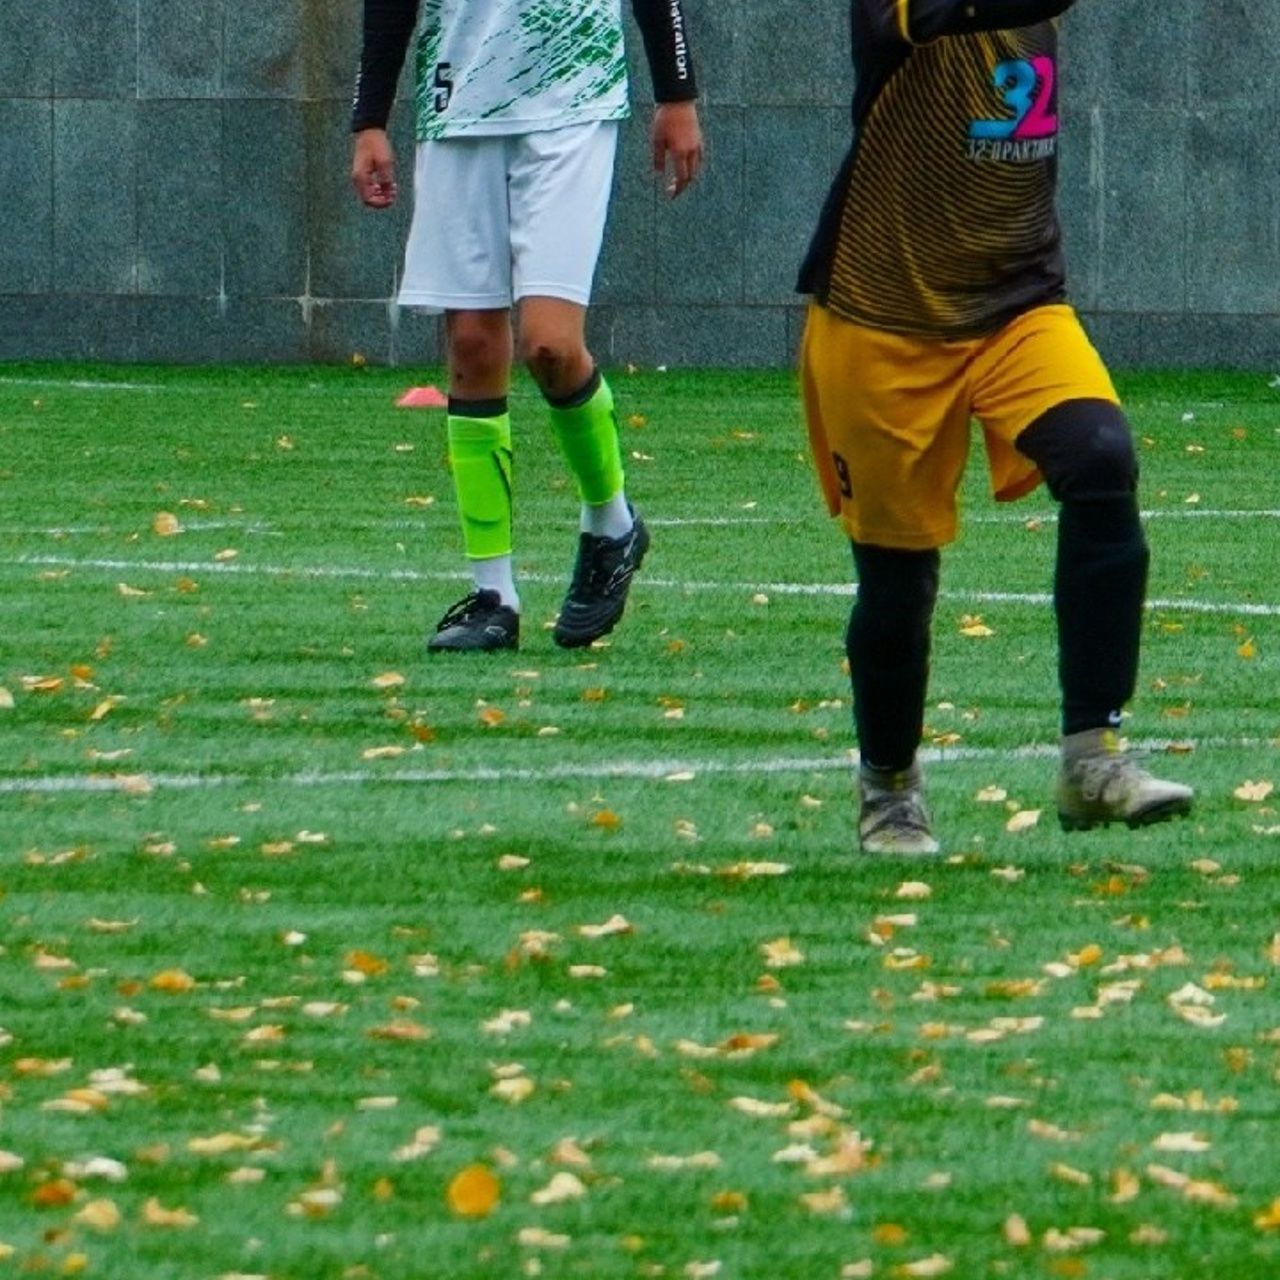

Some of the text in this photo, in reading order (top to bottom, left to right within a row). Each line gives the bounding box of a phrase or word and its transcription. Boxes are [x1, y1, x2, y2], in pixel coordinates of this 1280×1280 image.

[435, 62, 454, 113] 5
[967, 55, 1059, 140] 32
[832, 451, 853, 500] 9
